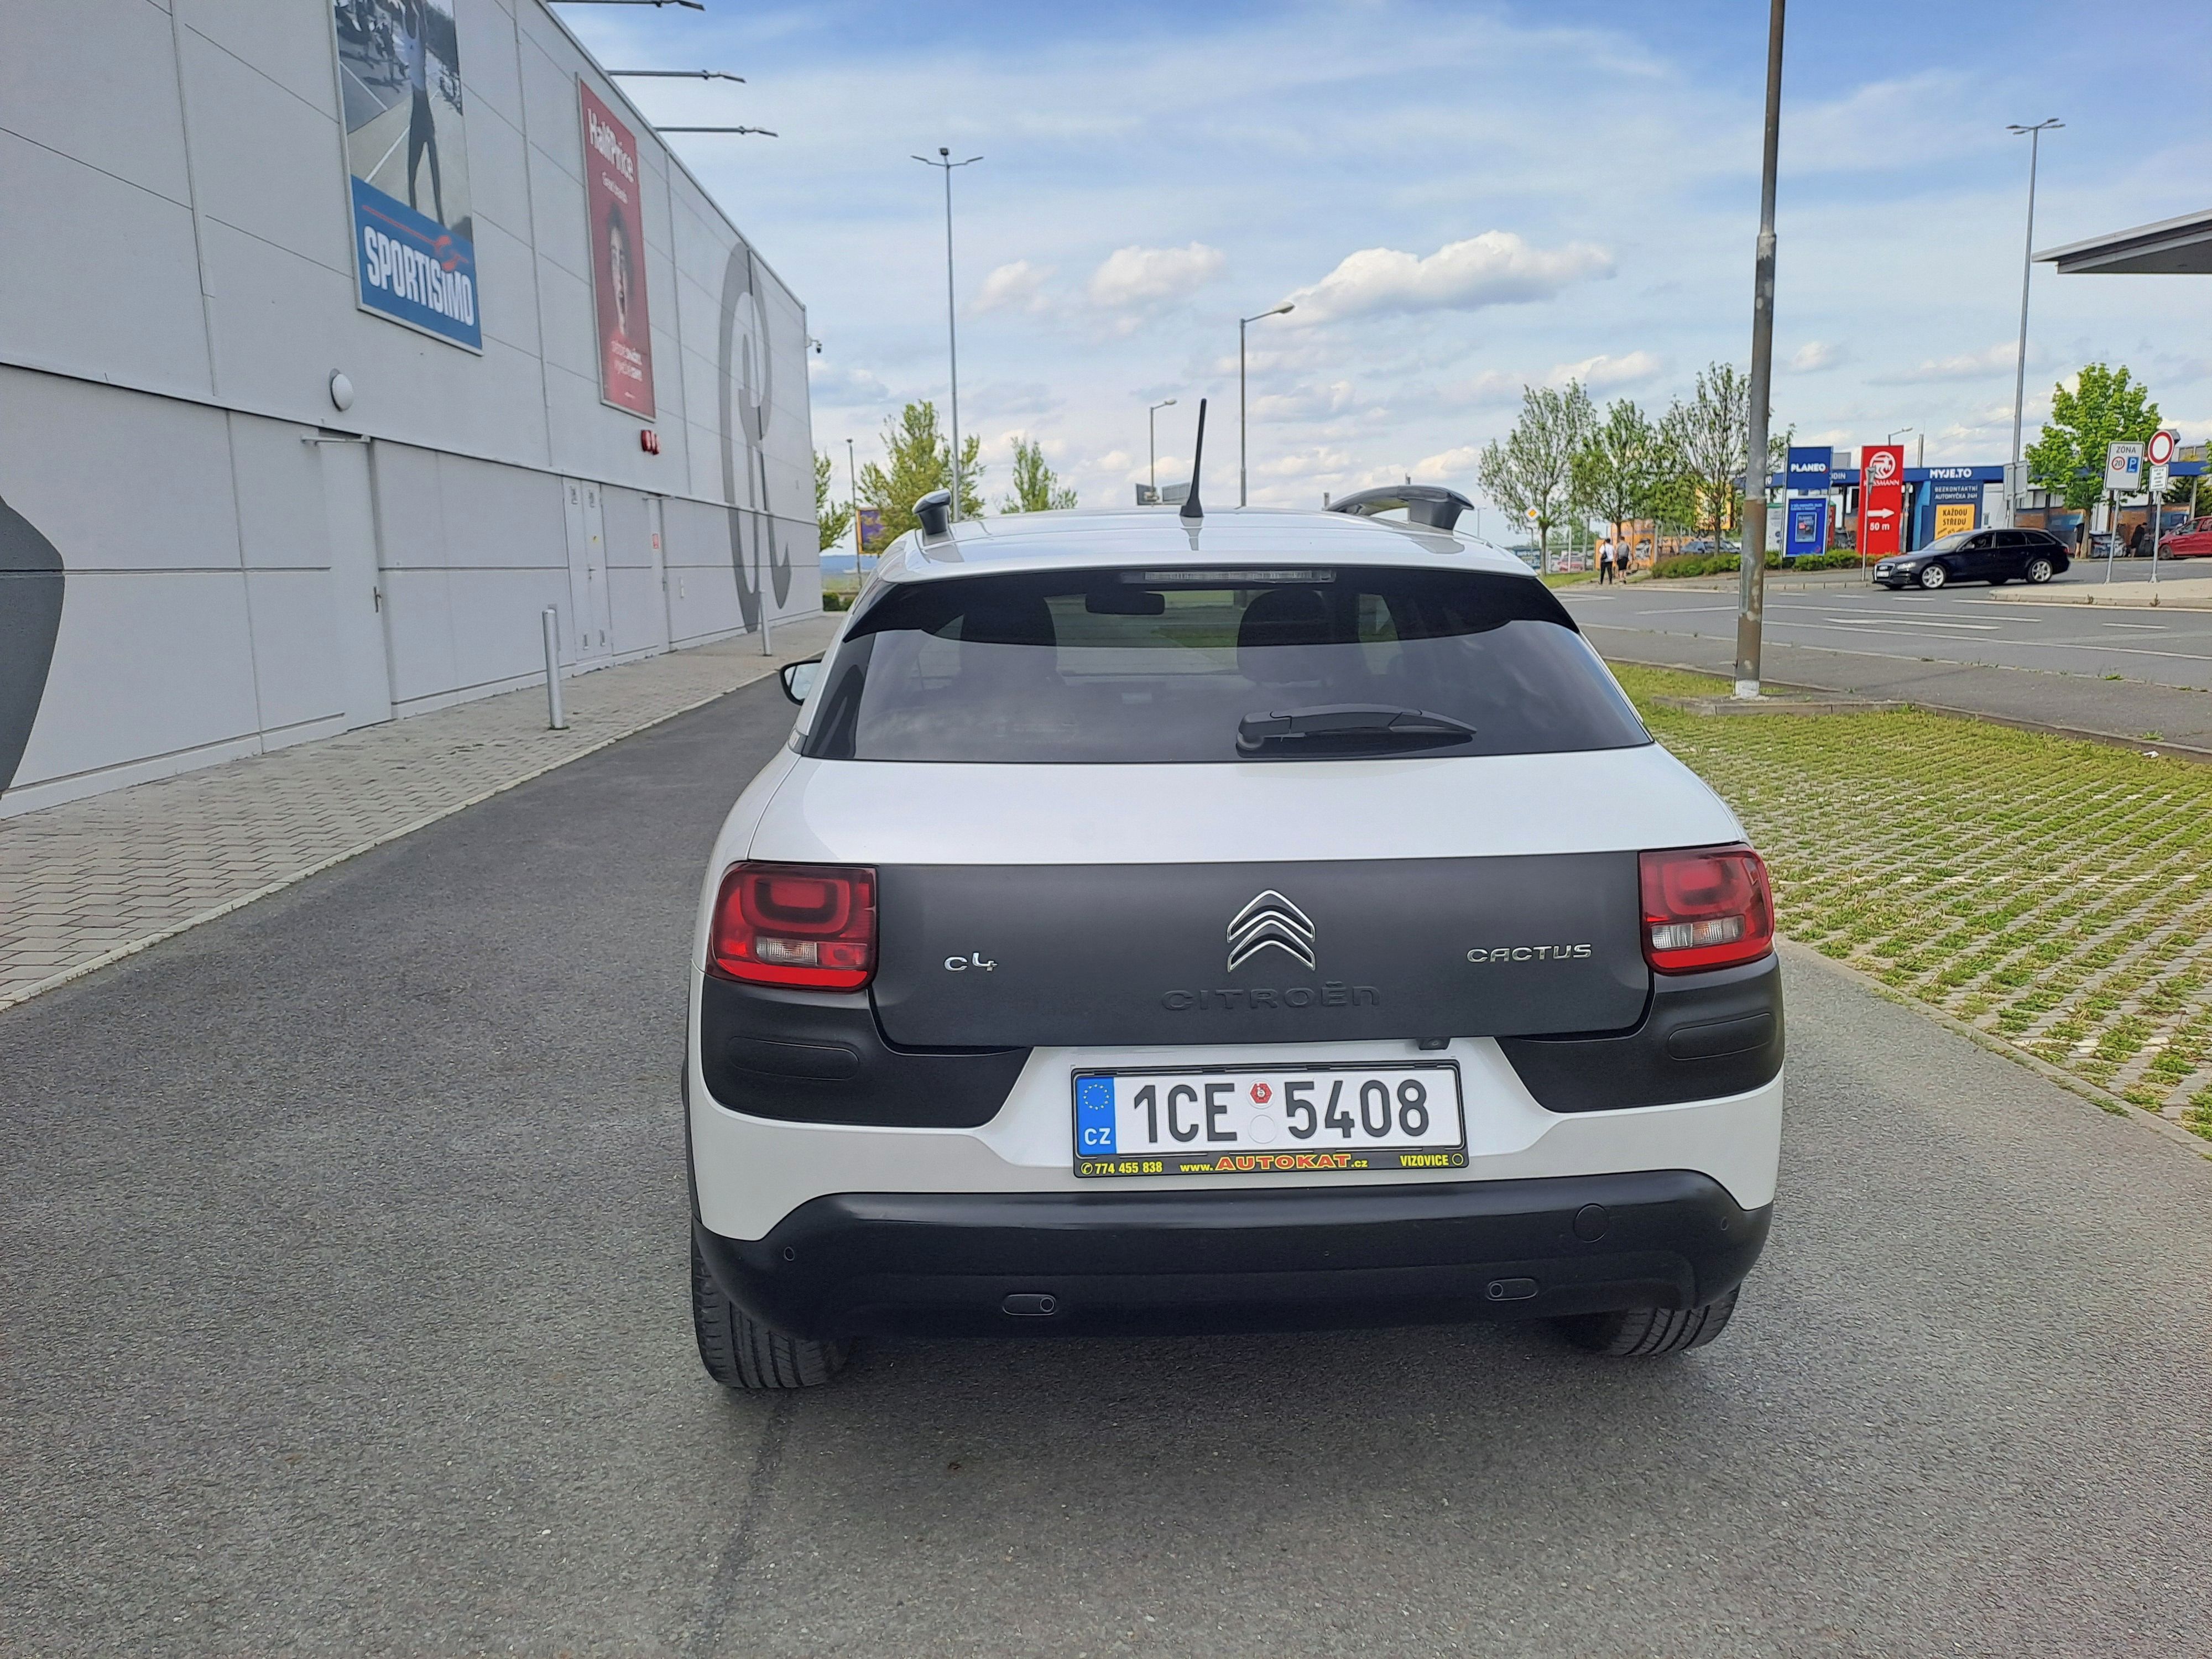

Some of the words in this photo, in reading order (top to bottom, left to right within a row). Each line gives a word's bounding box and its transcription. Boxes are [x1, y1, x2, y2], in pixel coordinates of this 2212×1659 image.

[363, 225, 474, 326] SPORTISIMO
[1791, 463, 1826, 472] PLANEO
[1929, 468, 1972, 479] MYJE.TO
[1466, 943, 1592, 963] CACTUS
[944, 952, 998, 972] C4
[1134, 1082, 1238, 1144] 1CE
[1284, 1079, 1428, 1140] 5408
[1084, 1128, 1112, 1145] CZ
[1094, 1163, 1115, 1175] 774
[1118, 1162, 1139, 1173] 455
[1142, 1161, 1163, 1173] 838
[1400, 1154, 1450, 1167] VIZOVICE
